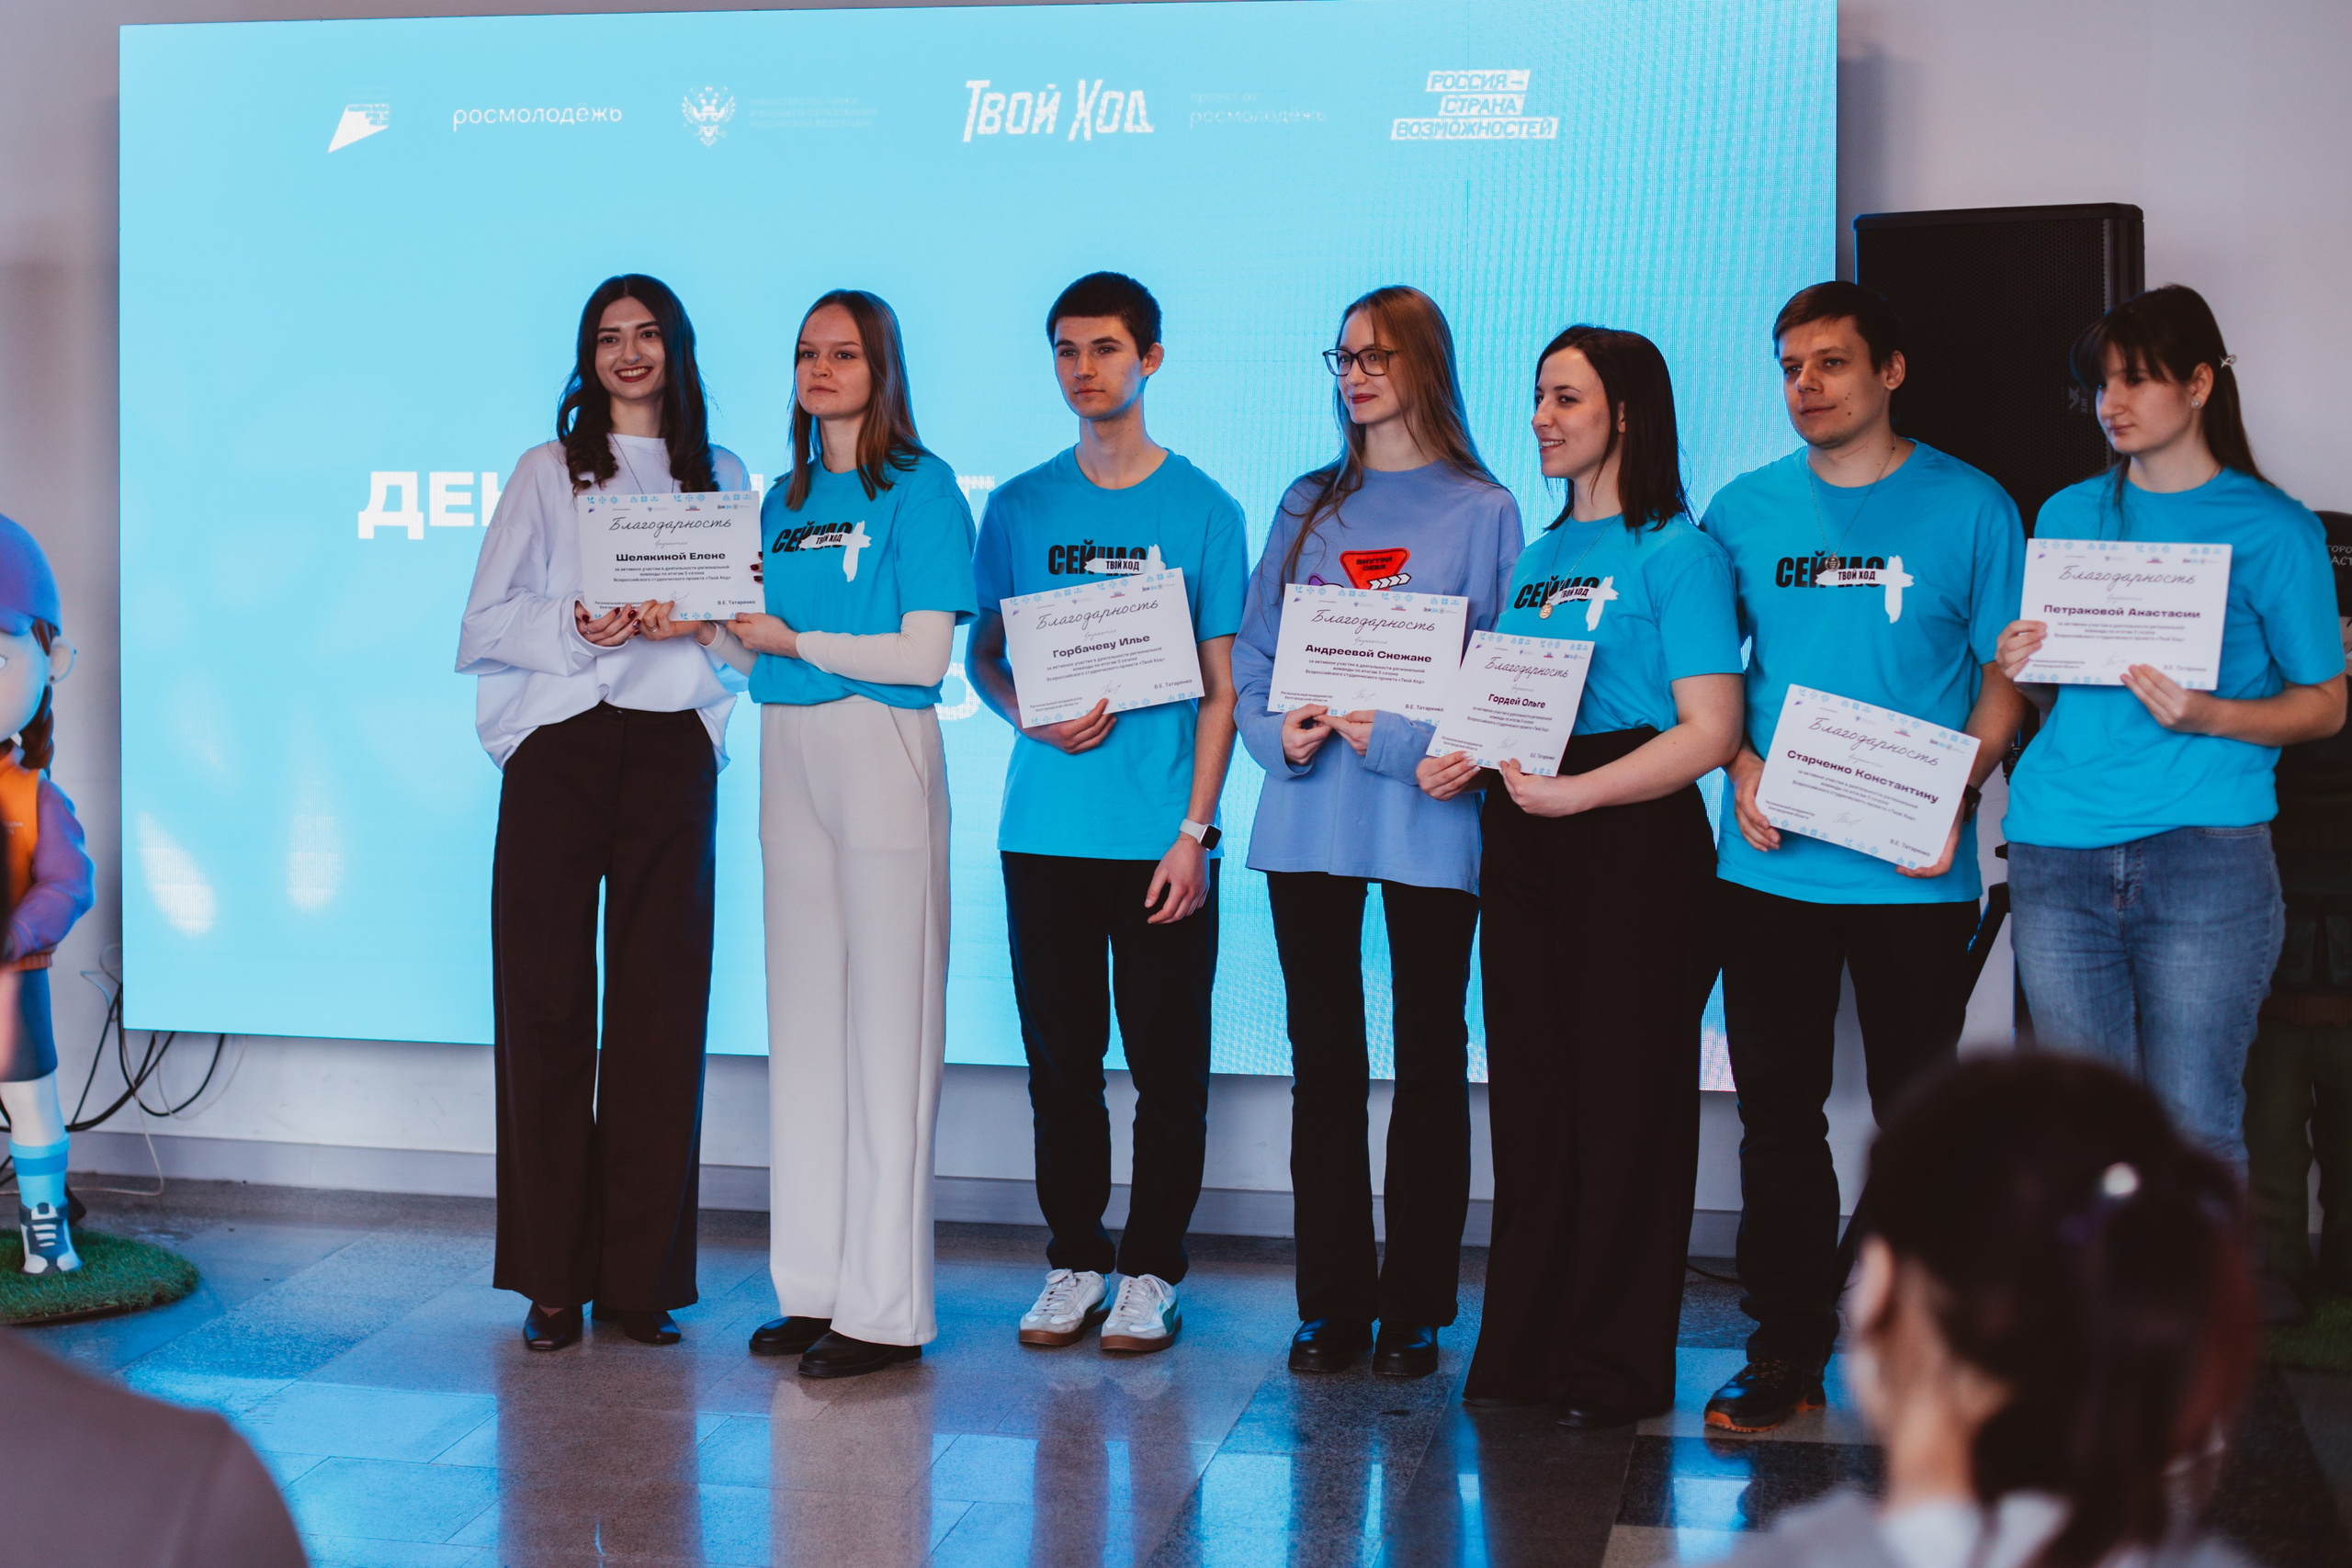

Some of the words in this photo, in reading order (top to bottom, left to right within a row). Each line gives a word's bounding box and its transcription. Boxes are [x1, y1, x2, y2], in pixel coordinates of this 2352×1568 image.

[1430, 73, 1508, 90] РОССИЯ
[1443, 97, 1517, 114] СТРАНА
[453, 103, 622, 132] росмолодёжь
[1396, 118, 1554, 138] ВОЗМОЖНОСТЕЙ
[609, 517, 731, 538] Благодарность
[616, 552, 686, 561] Шелякиной
[689, 552, 726, 560] Елене
[1105, 559, 1122, 570] ТВОЙ
[1123, 560, 1139, 571] ХОД
[1356, 557, 1393, 565] ВНУТРИ
[1776, 550, 1884, 588] СЕЙАС
[1838, 569, 1857, 581] ТВОЙ
[1859, 570, 1875, 581] ХОД
[2058, 565, 2195, 592] Благодарность
[1036, 600, 1159, 630] Благодарность
[2043, 604, 2124, 615] Петраковой
[2128, 608, 2200, 618] Анастасии
[1311, 609, 1435, 634] Благодарность
[1053, 641, 1116, 658] Горбачеву
[1119, 636, 1150, 647] Илье
[1305, 645, 1374, 658] Андреевой
[1377, 650, 1431, 662] Снежане
[1485, 657, 1568, 682] Благодарность
[1165, 679, 1193, 687] Татаренко
[1488, 694, 1521, 705] Гордей
[1521, 698, 1545, 708] Ольге
[1808, 717, 1939, 766] Благодарность
[1787, 750, 1852, 774] Старченко
[1855, 769, 1939, 804] Константину
